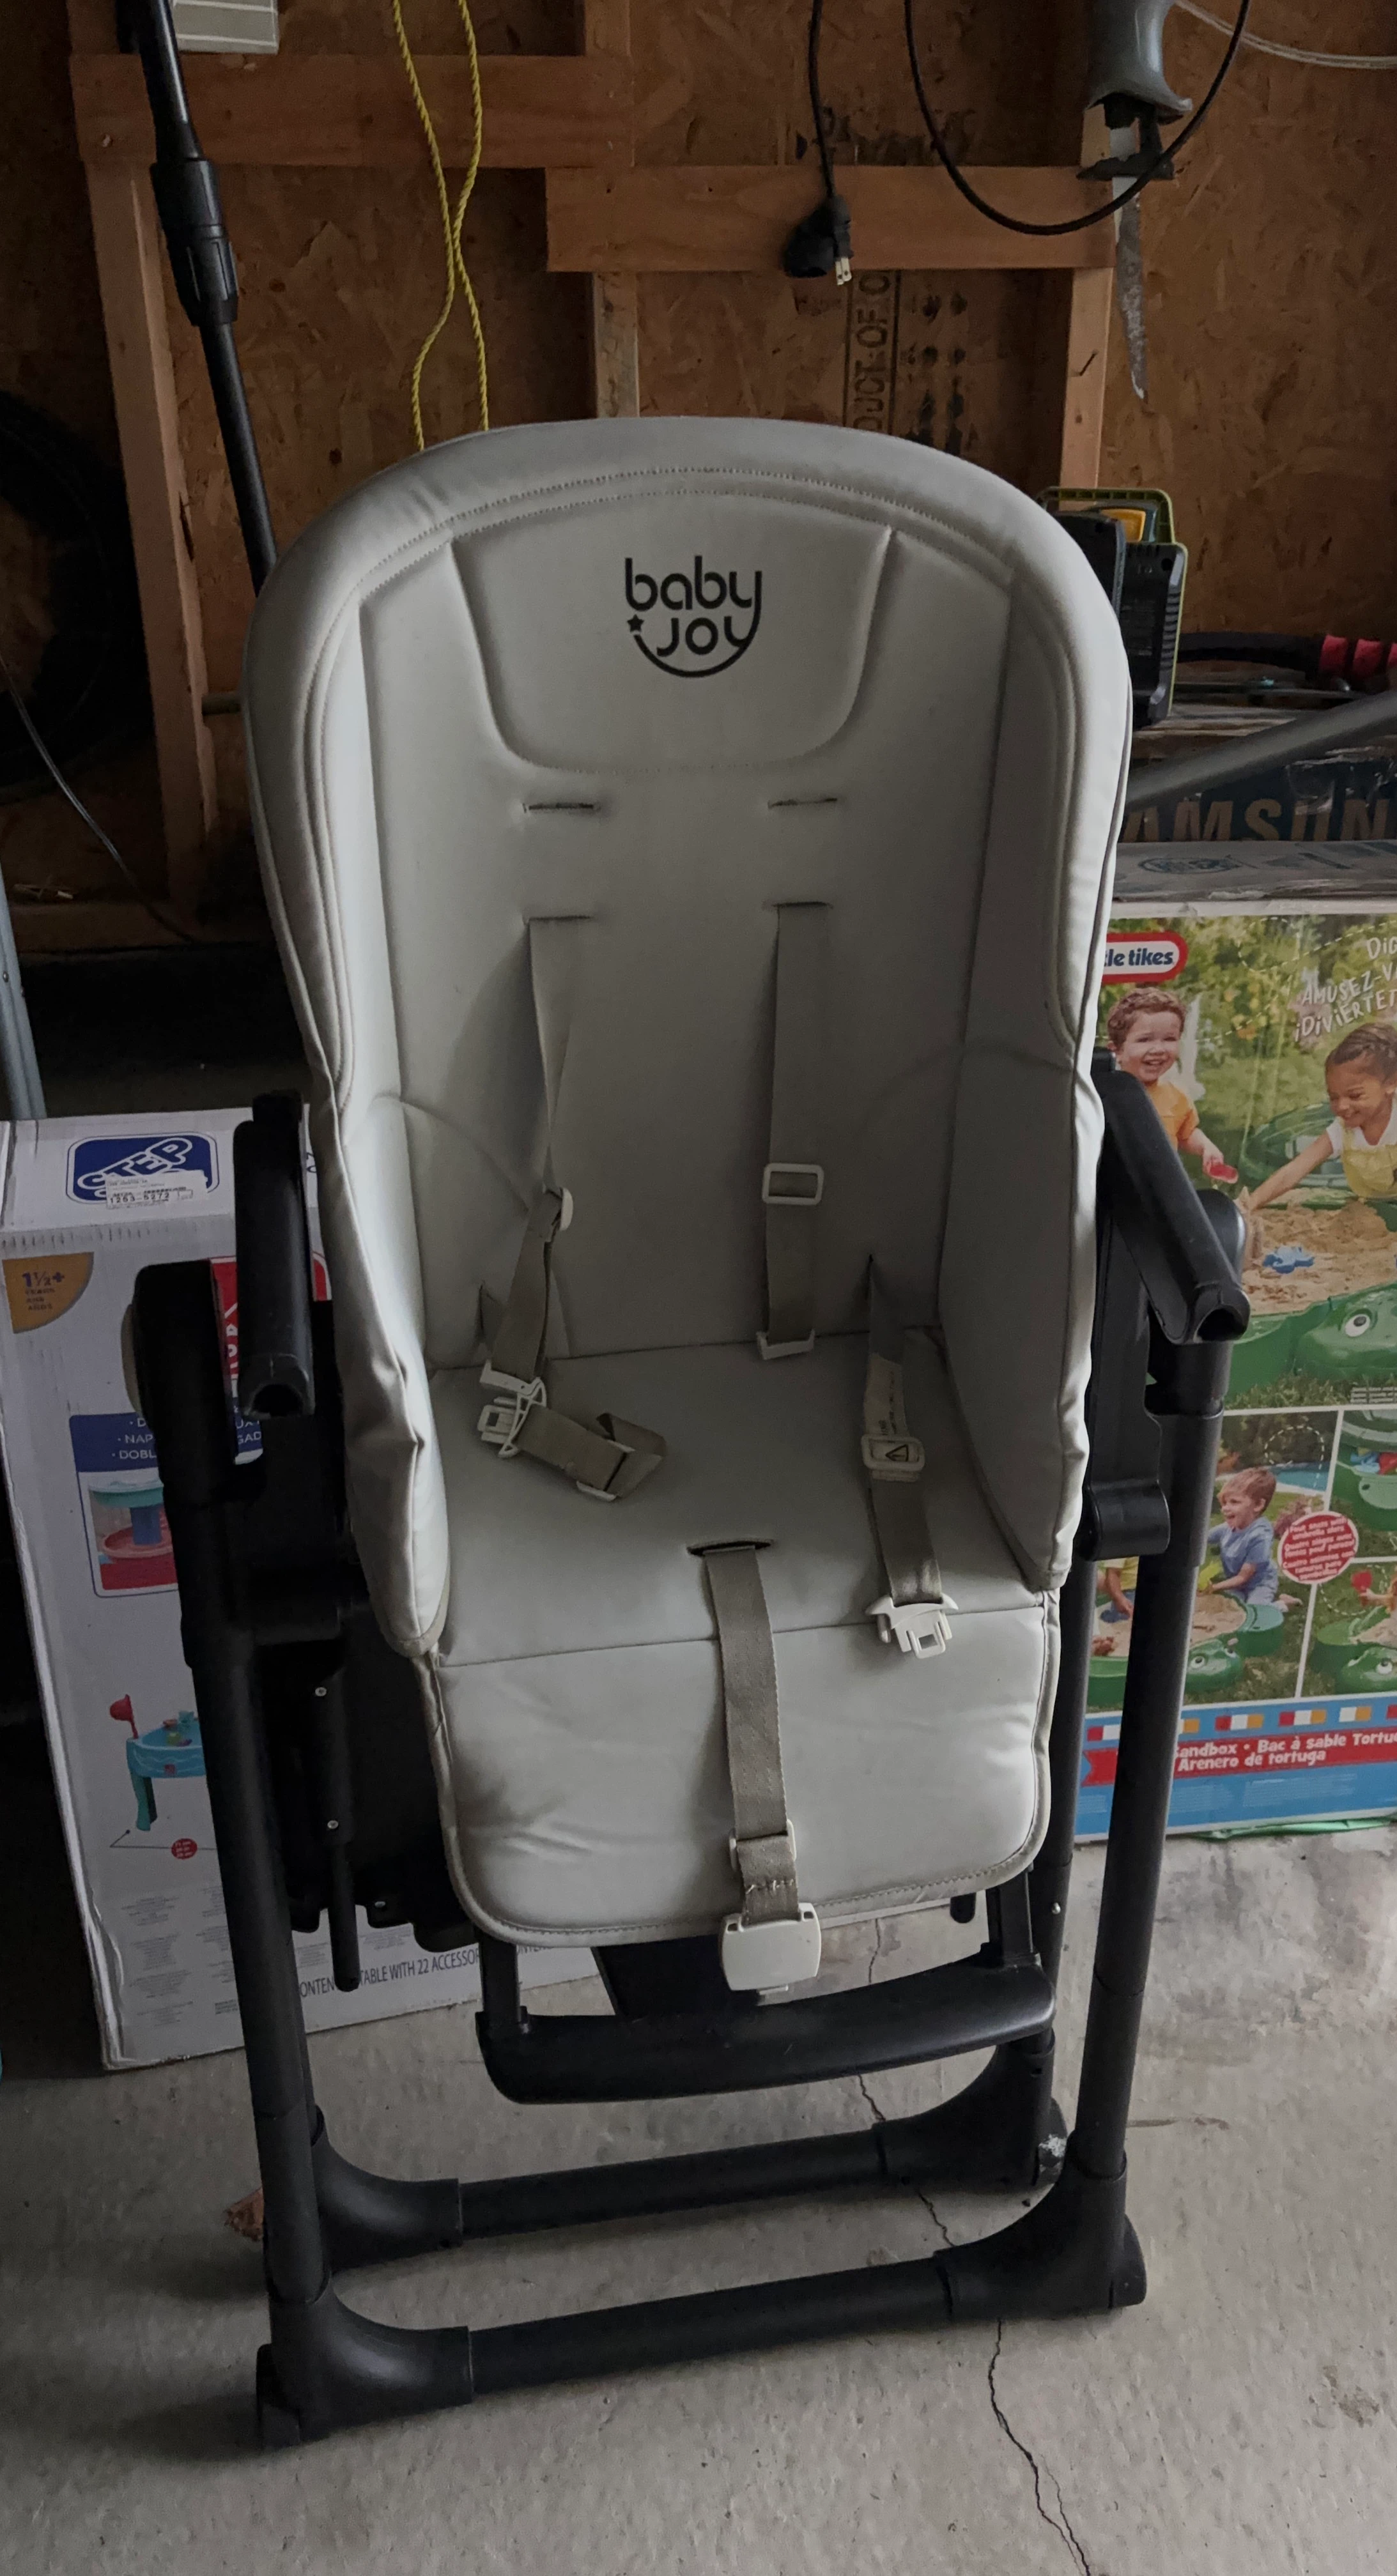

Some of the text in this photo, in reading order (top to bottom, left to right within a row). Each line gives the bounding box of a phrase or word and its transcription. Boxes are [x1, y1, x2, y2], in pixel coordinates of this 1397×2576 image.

[624, 555, 762, 613] baby
[654, 615, 757, 658] joy
[1129, 947, 1173, 966] tikes
[1301, 962, 1397, 1005] AMUSEZ-V
[1177, 1750, 1327, 1772] Arenero de tortuga
[1257, 1739, 1286, 1753] Bac
[1290, 1735, 1301, 1750] à
[1306, 1733, 1347, 1749] sable
[298, 1977, 334, 1997] ONTEN
[359, 1965, 388, 1985] TABLE
[389, 1959, 415, 1980] WITH
[417, 1958, 429, 1975] 22
